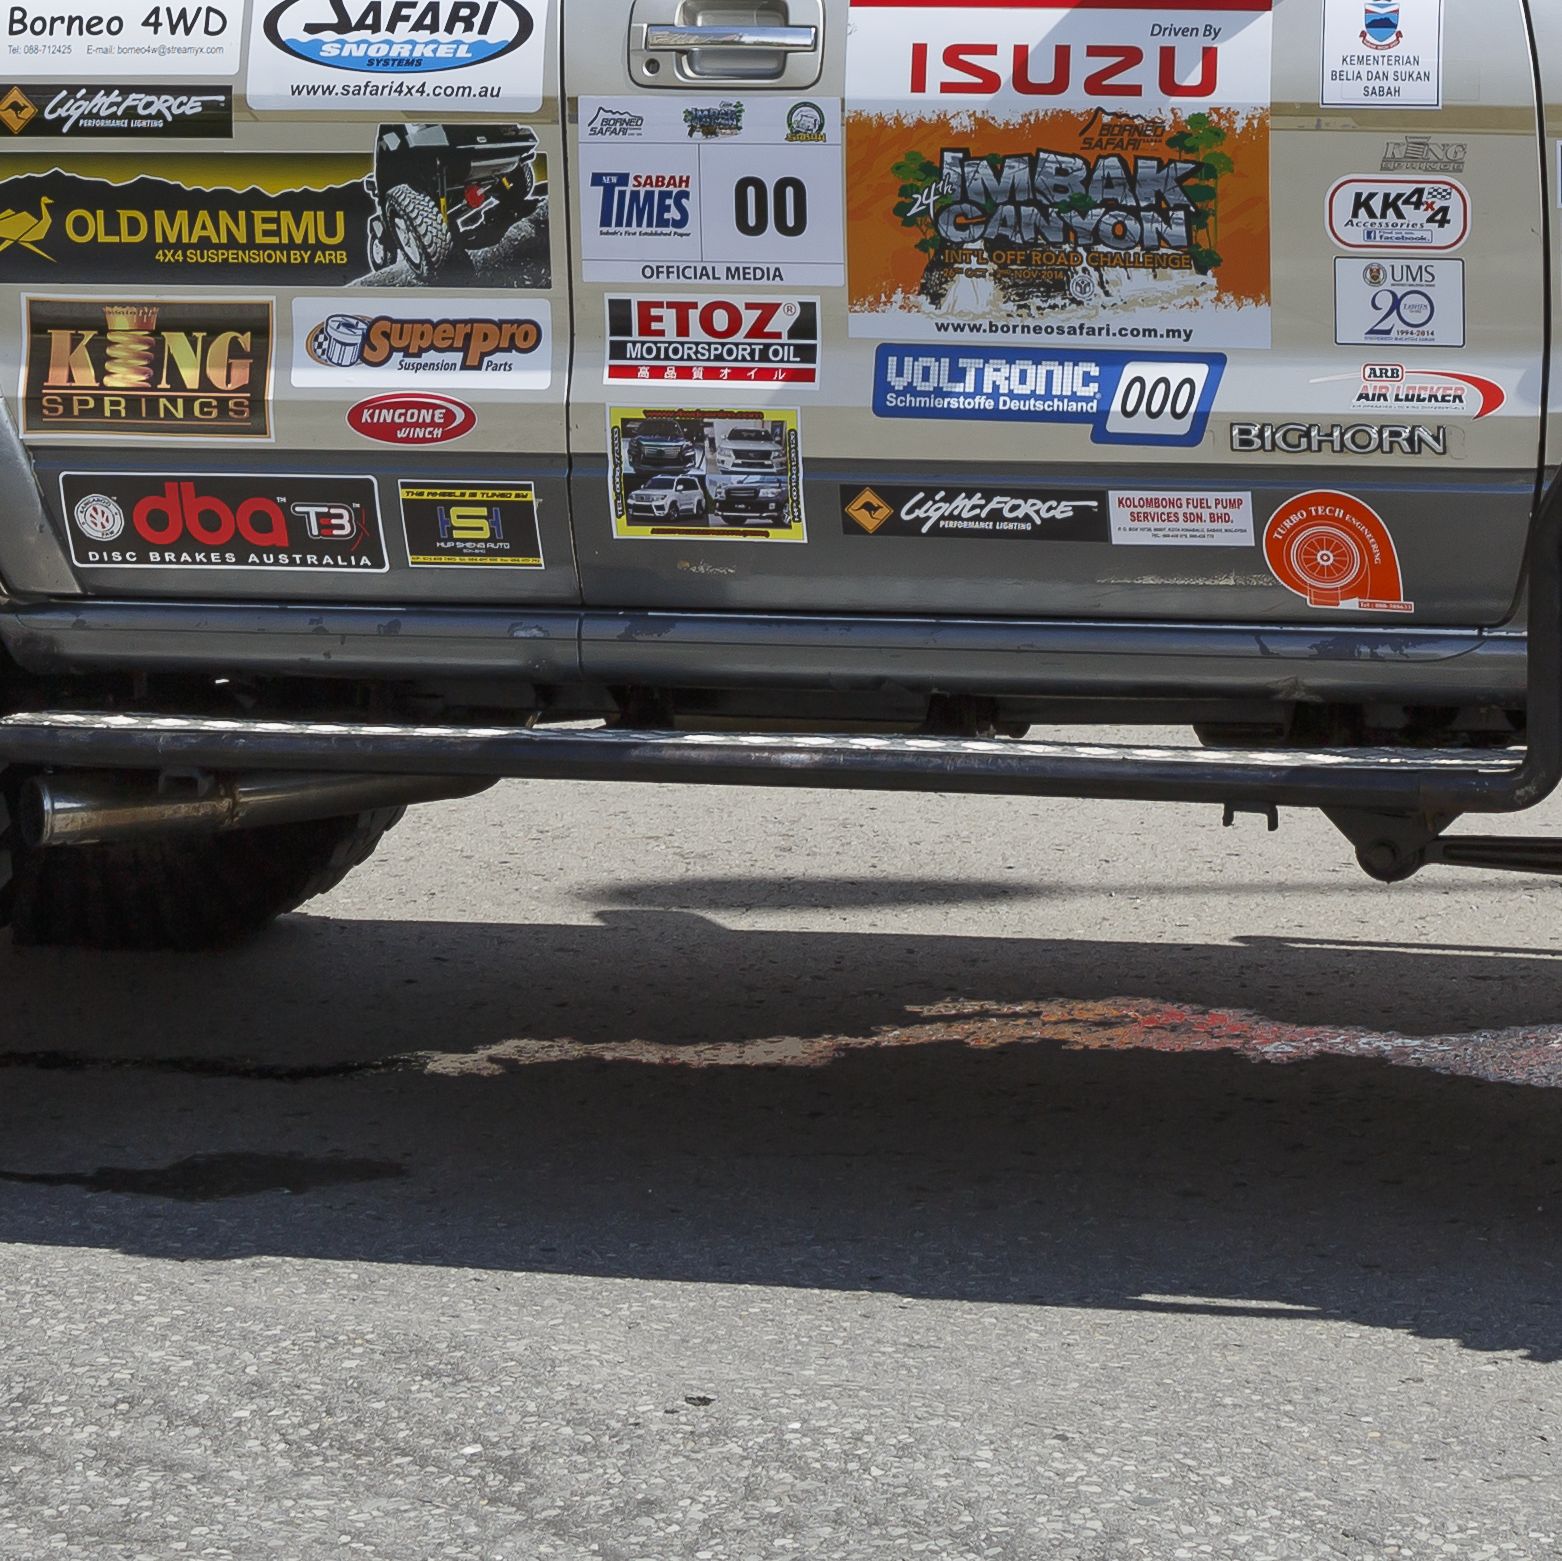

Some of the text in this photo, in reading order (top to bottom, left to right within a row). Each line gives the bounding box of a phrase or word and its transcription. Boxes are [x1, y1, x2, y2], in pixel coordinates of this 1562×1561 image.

[8, 5, 228, 37] Borneo 4WD
[1149, 23, 1222, 41] Driven By
[8, 44, 115, 55] Tel: 088-712425 E-mail:
[319, 43, 473, 58] SNORKEL
[366, 58, 423, 67] SYSTEMS
[1341, 54, 1420, 67] KEMENTERIAN
[910, 42, 1219, 98] ISUZU
[1330, 70, 1431, 83] BELIA DAN SUKAN
[290, 80, 502, 99] www.safari4x4.com.au
[1363, 85, 1401, 98] SABAH
[79, 119, 164, 128] PERFORMANCE LIGHTING
[600, 117, 644, 127] BORNEO
[1097, 123, 1165, 137] BORNEO
[589, 127, 628, 136] SAFARI
[1080, 137, 1142, 151] SAFARI
[602, 174, 691, 189] NEW SABAH
[906, 147, 1204, 218] 24th IMBAK
[590, 172, 691, 229] TIMES
[734, 175, 807, 238] 00
[65, 209, 345, 245] OLD MAN EMU
[938, 203, 1191, 249] CANYON
[1344, 219, 1425, 229] Accessories
[155, 250, 348, 265] 4X4 SUSPENSION BY ARB
[944, 250, 1191, 269] INT'L OFF ROAD CHALLENGE
[641, 264, 784, 281] OFFICIAL MEDIA
[1014, 269, 1064, 279] NOV 2014
[1390, 264, 1436, 283] UMS
[636, 300, 783, 340] ETOZ
[1364, 289, 1435, 336] 20
[934, 320, 1194, 342] www.borneosafari.com.my
[626, 343, 801, 362] MOTORSPORT OIL
[397, 359, 513, 374] Suspension Parts
[1367, 367, 1400, 379] ARB
[886, 355, 1100, 397] VOLTRONIC
[1120, 376, 1196, 420] 000
[1355, 385, 1466, 403] AIR LOCKER
[42, 396, 251, 420] SPRINGS
[886, 393, 1097, 414] Schmierstoffe Deutschland
[361, 408, 447, 424] KINGONE
[396, 427, 443, 439] WINCH
[1230, 422, 1447, 456] BIGHORN
[1117, 497, 1244, 510] KOLOMBONG FUEL PUMP
[132, 482, 289, 547] dba
[1129, 511, 1234, 524] SERVICES SDN. BHD.
[939, 520, 1032, 531] PERFORMANCE LIGHTING
[1273, 505, 1382, 565] TURBO TECH ENGINEERING
[88, 551, 372, 567] DISC BRAKES AUSTRALIA
